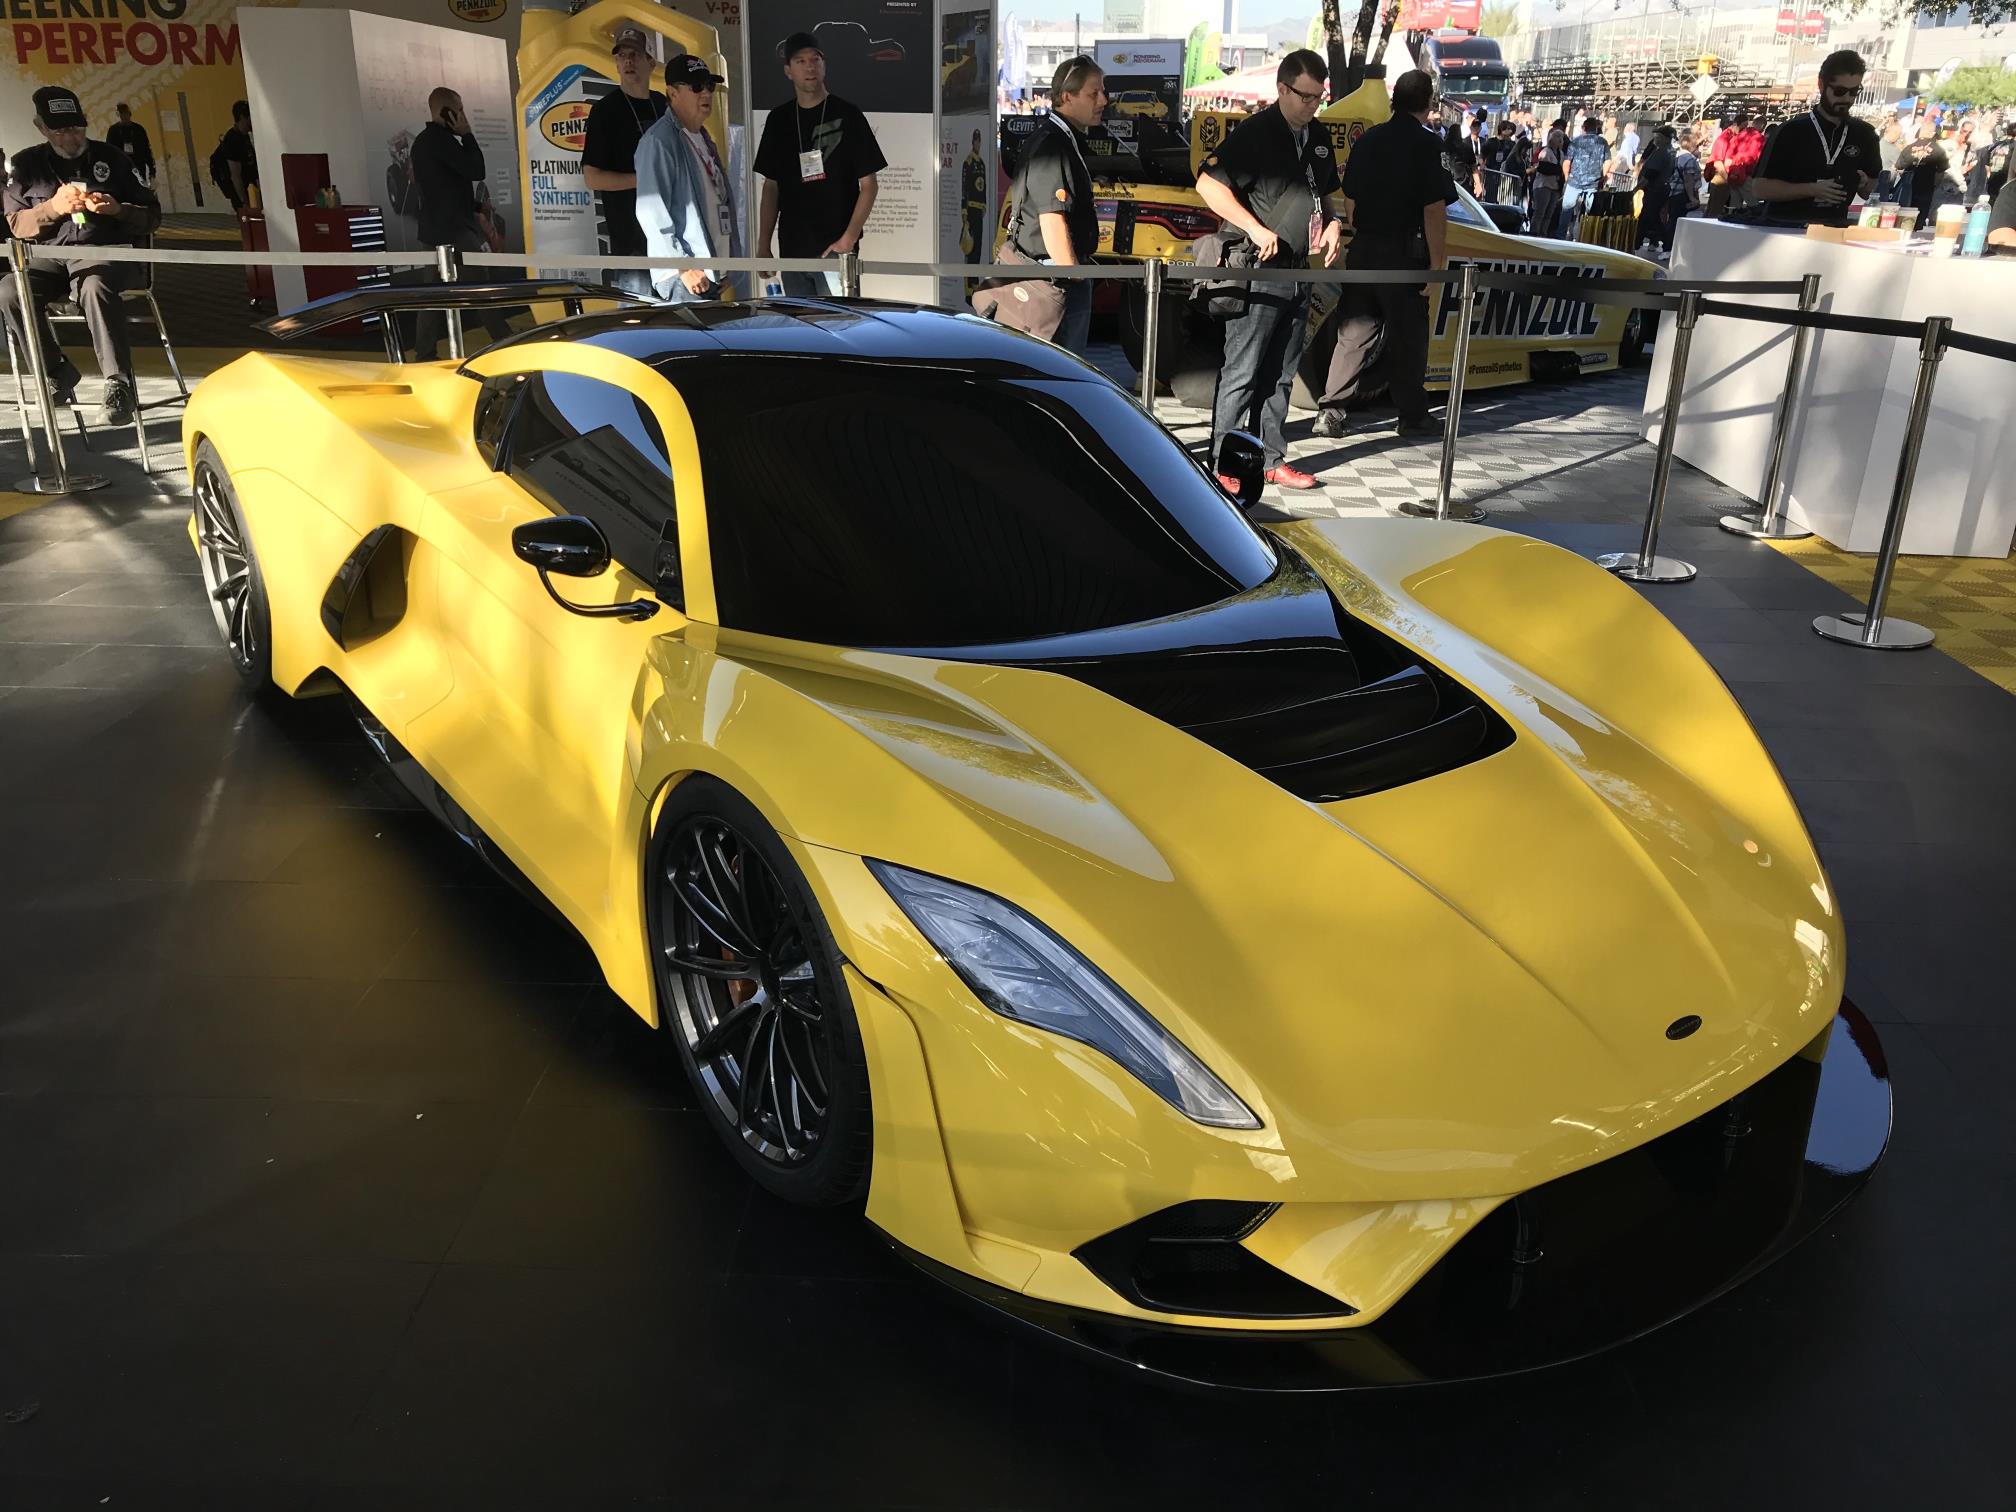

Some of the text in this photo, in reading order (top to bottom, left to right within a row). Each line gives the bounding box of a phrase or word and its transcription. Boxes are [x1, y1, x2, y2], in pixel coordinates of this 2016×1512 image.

[1007, 119, 1036, 132] CLEVITE
[946, 143, 958, 154] R/T
[531, 160, 584, 175] PLATINUM
[532, 176, 557, 190] FULL
[533, 191, 591, 206] SYNTHETIC
[1433, 257, 1606, 338] PENNZOIL
[1468, 361, 1522, 376] #PennzoilSynthetics
